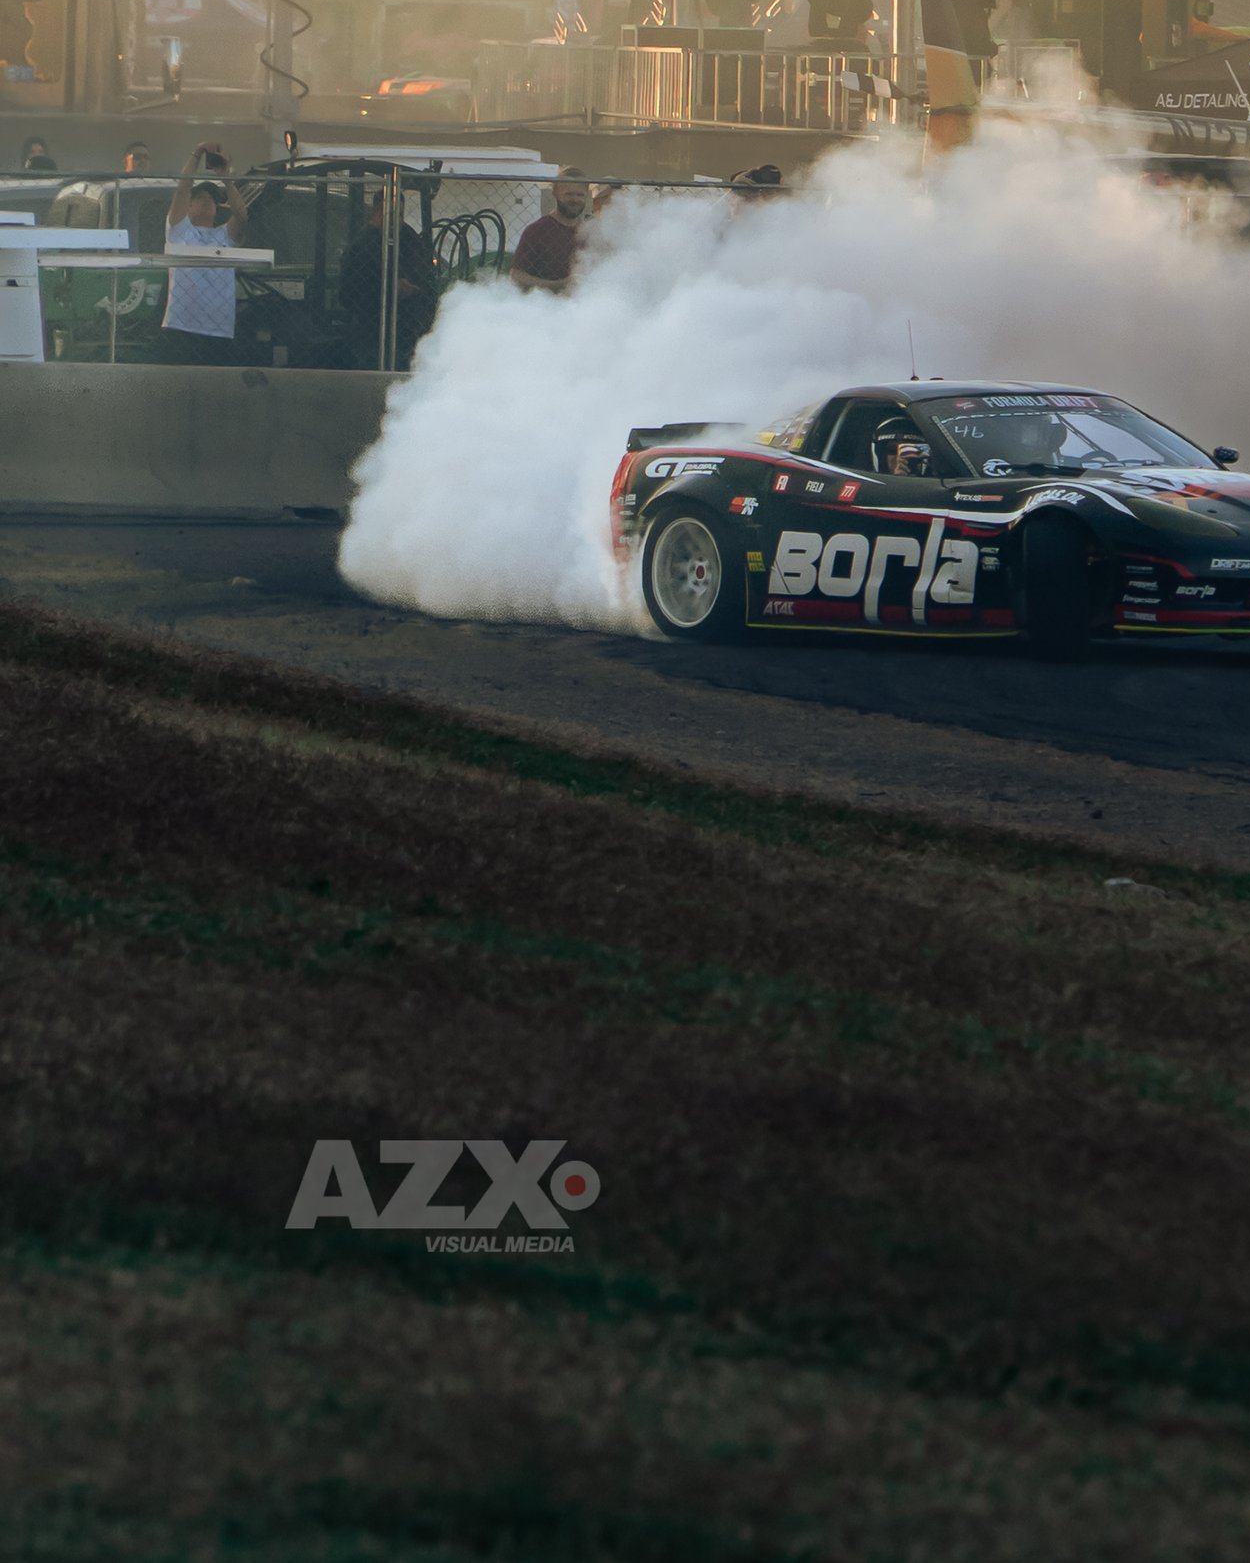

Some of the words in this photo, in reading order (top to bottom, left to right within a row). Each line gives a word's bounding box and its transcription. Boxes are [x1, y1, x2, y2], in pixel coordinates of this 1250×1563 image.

[1155, 93, 1182, 109] A&J
[982, 395, 1050, 408] FORMULA
[1047, 395, 1099, 408] DRIFT
[954, 424, 985, 439] 46
[804, 480, 825, 494] FIELD
